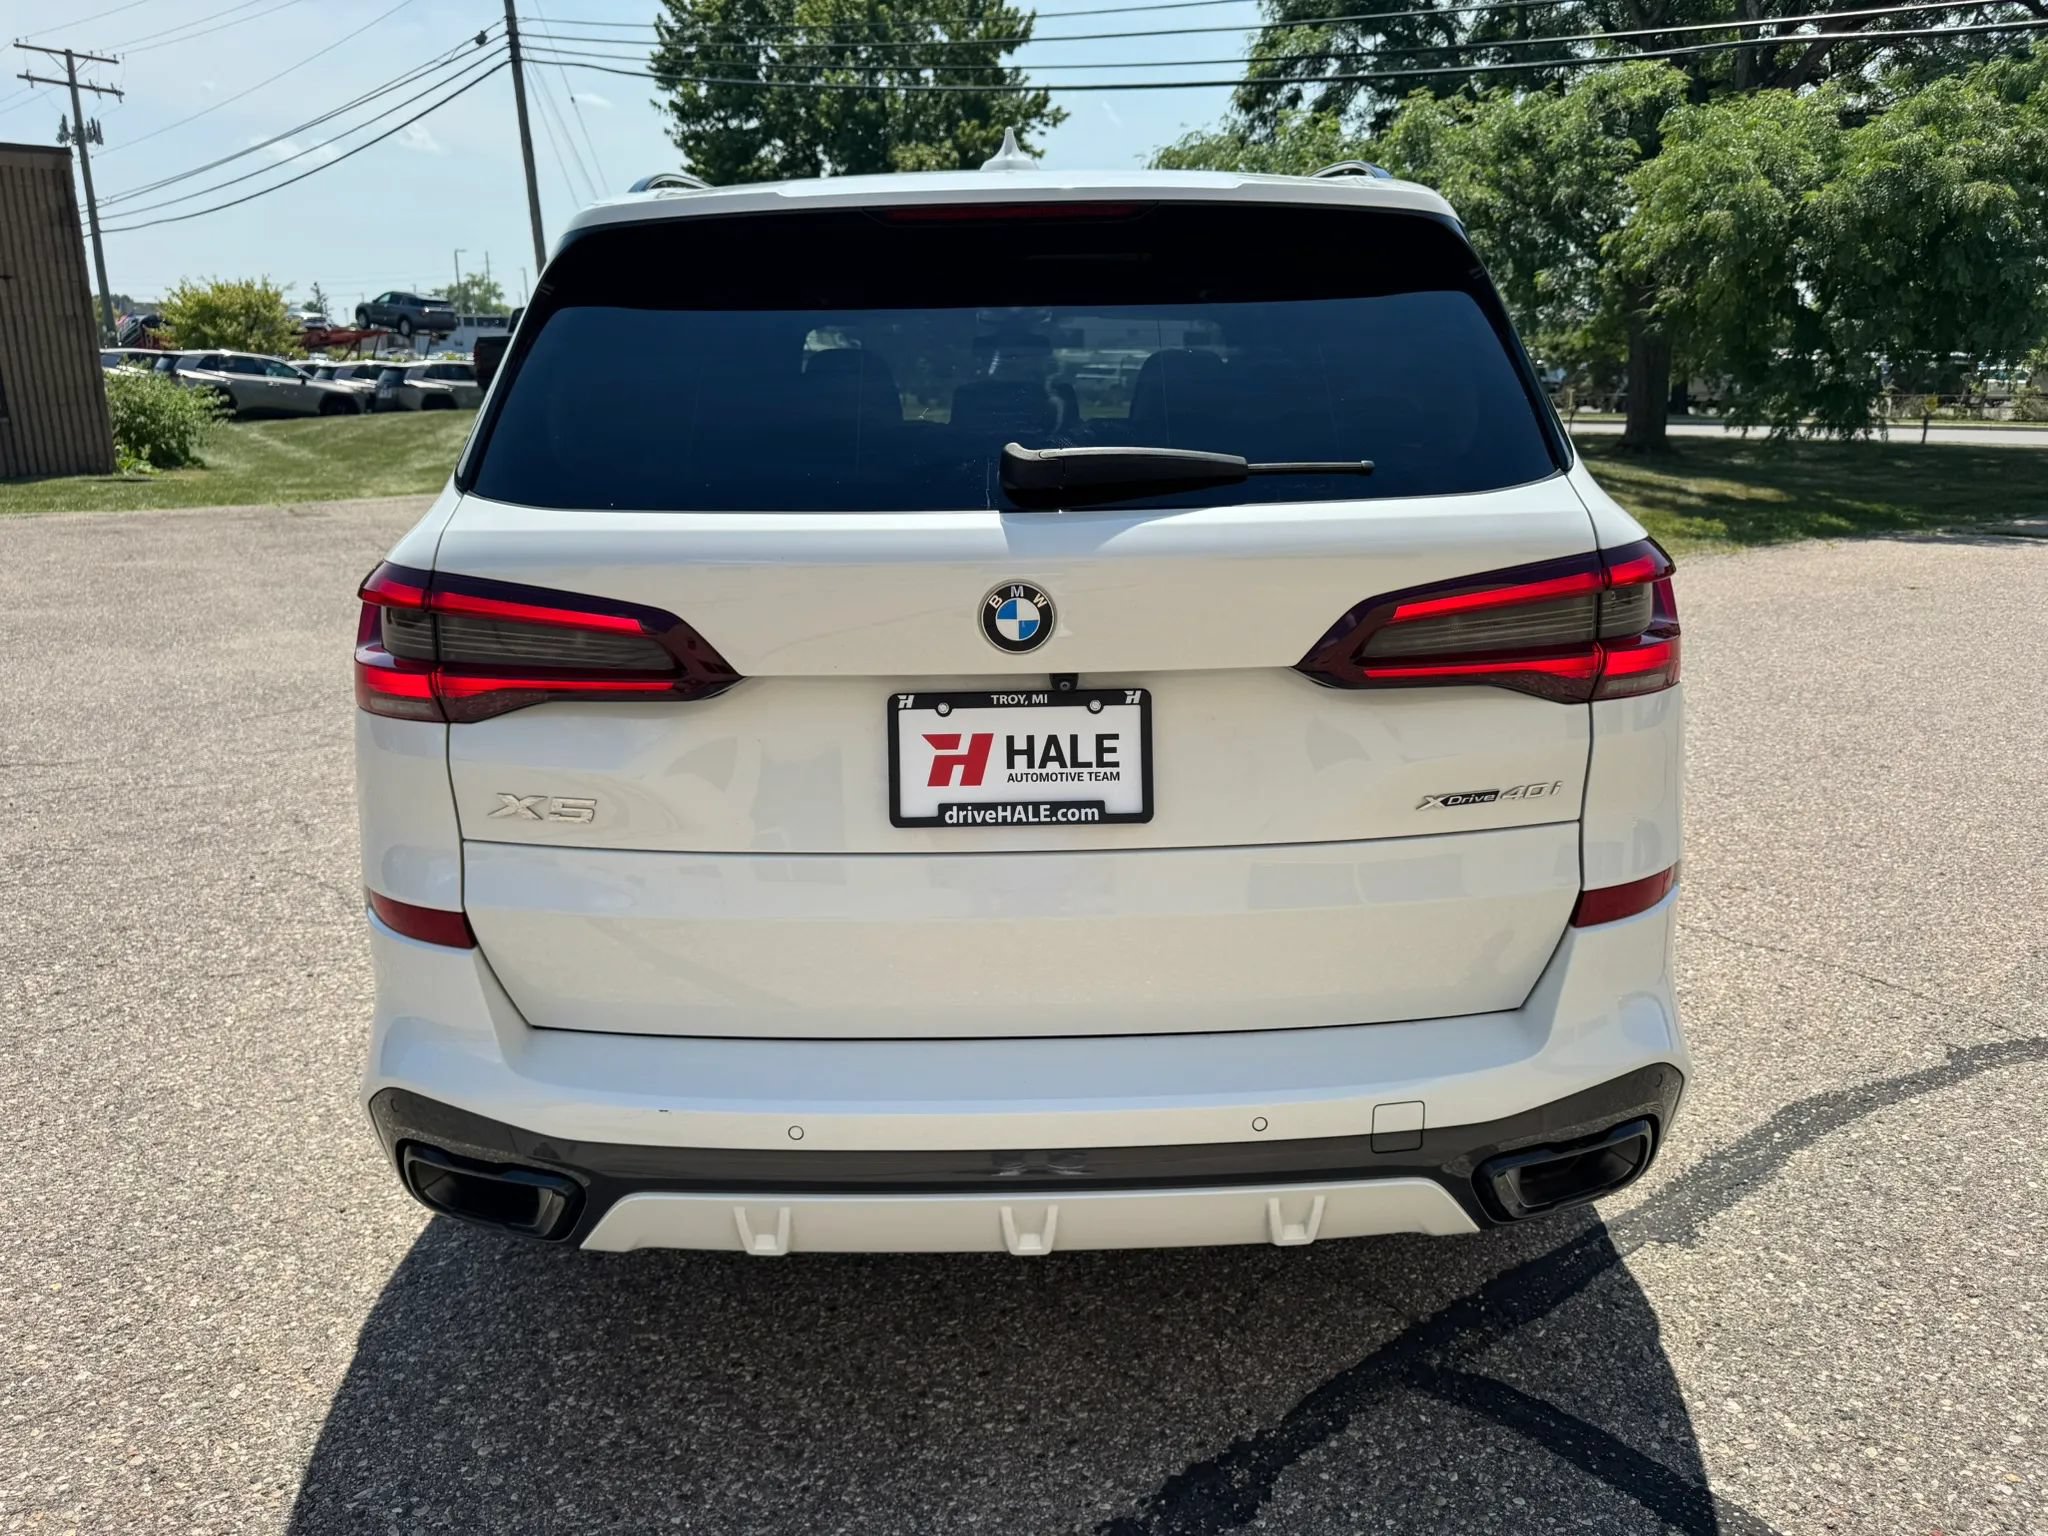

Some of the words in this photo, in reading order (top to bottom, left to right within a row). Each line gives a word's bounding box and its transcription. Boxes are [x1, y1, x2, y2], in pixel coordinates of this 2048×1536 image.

[988, 585, 1047, 609] BMW
[991, 694, 1030, 706] TROY,
[1032, 693, 1048, 705] MI
[1005, 733, 1120, 770] HALE
[1006, 772, 1085, 783] AUTOMOTIVE
[1087, 771, 1121, 782] TEAM
[486, 792, 598, 824] X5
[944, 804, 1099, 824] driveHALE.com
